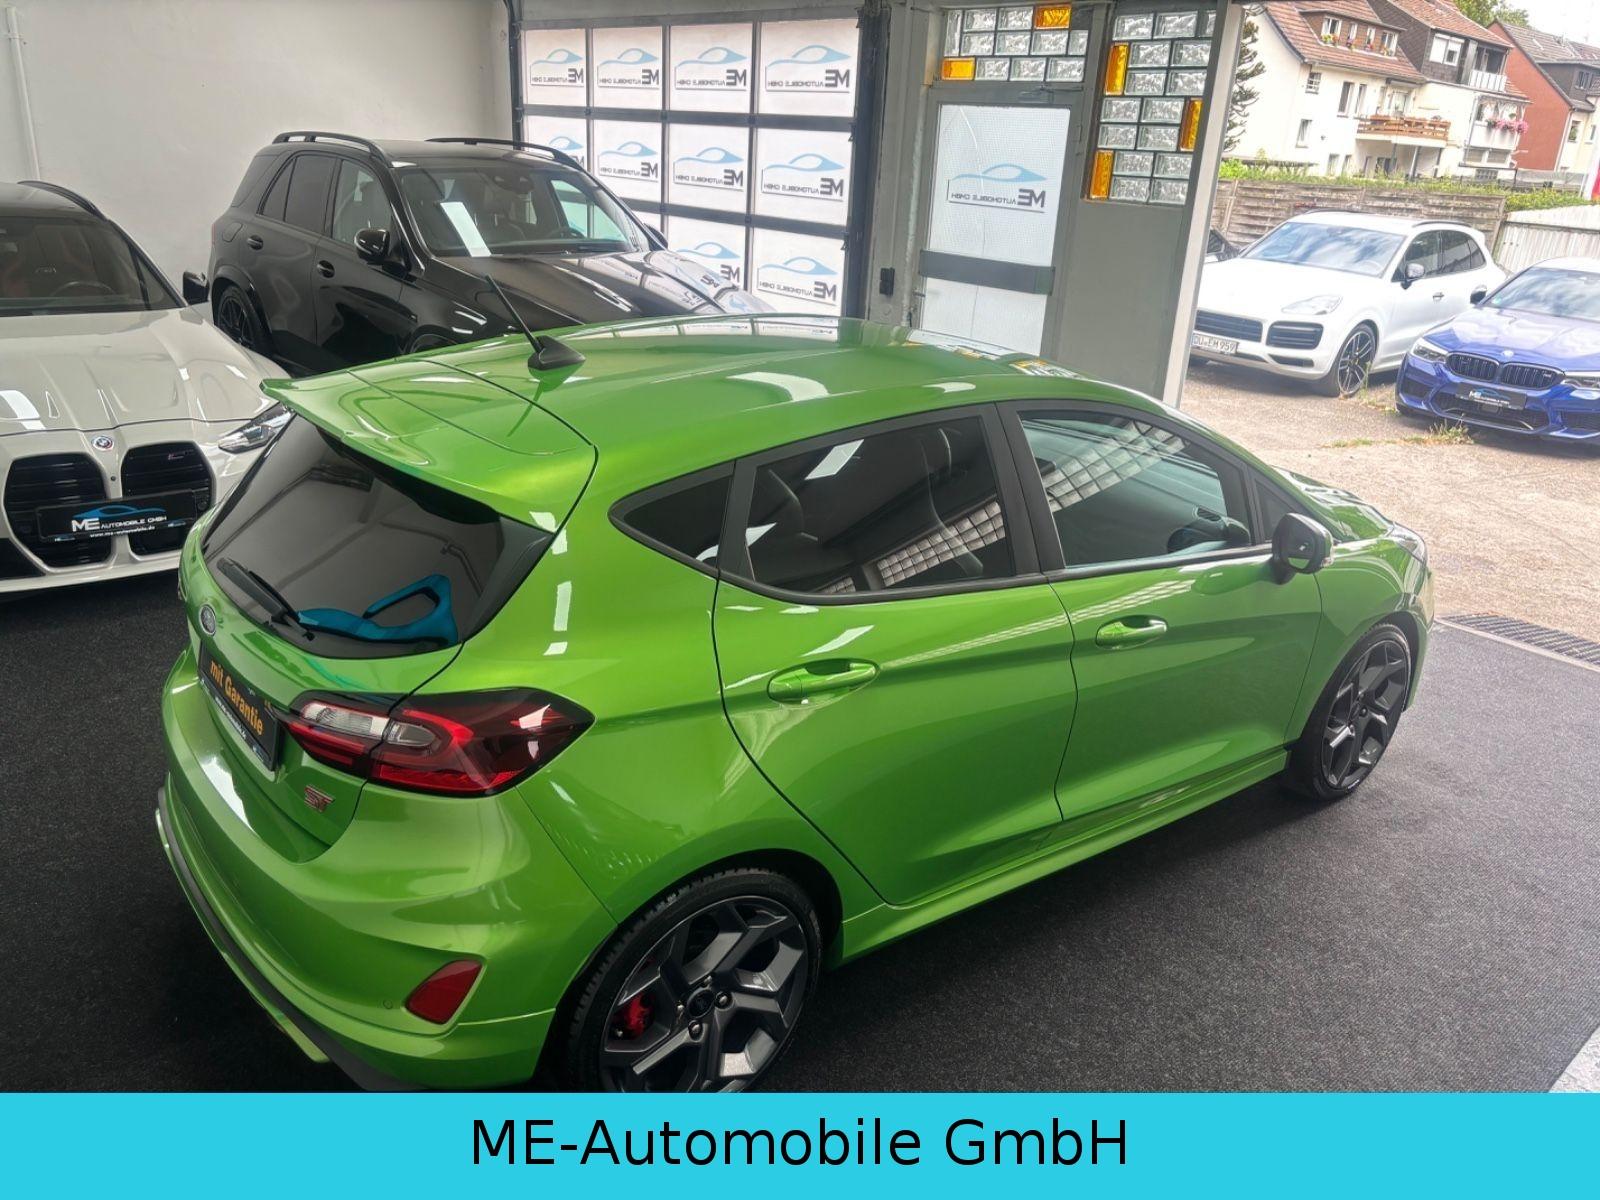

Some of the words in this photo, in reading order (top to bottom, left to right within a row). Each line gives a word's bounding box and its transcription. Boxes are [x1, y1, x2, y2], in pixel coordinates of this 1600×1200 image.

[72, 518, 100, 532] ME
[101, 519, 146, 529] AUTOMOBILE
[211, 660, 224, 688] mit
[225, 675, 264, 736] Garantie
